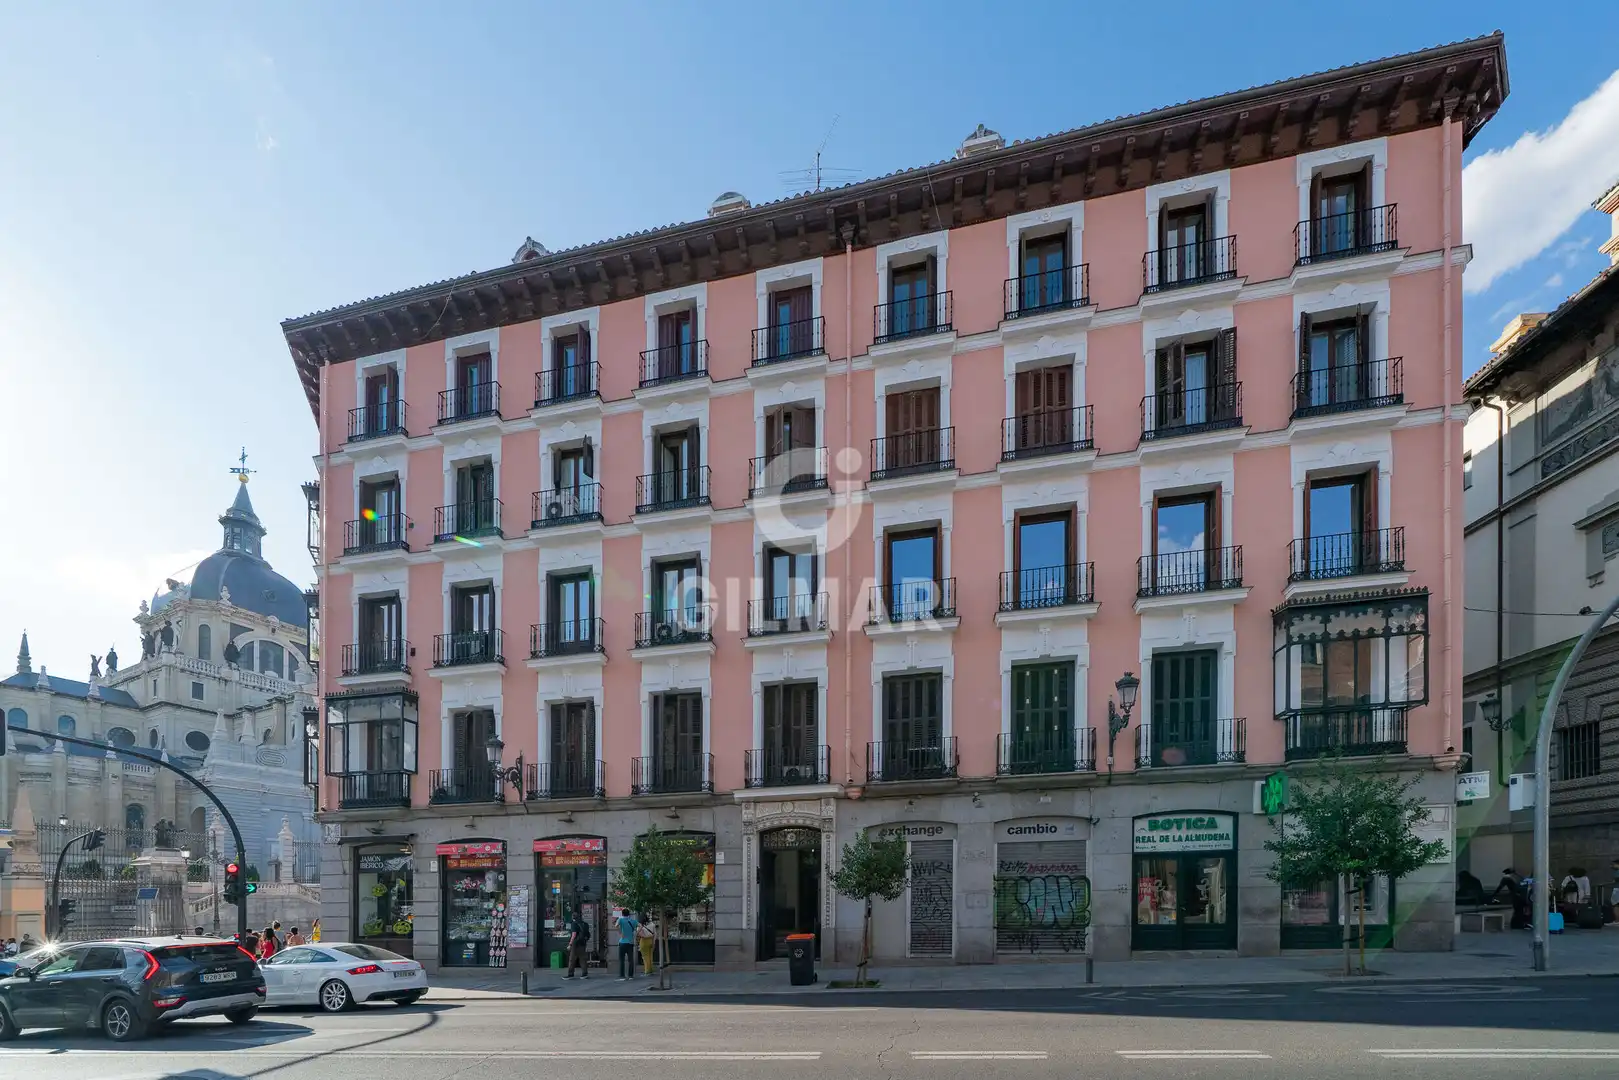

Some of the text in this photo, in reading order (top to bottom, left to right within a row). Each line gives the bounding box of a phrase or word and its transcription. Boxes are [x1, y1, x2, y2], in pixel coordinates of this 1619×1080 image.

[1007, 823, 1058, 835] cambio
[1148, 816, 1218, 831] BOTICA
[1135, 833, 1231, 844] REAL DE LA ALMUDENA
[360, 853, 381, 863] JAMÓN
